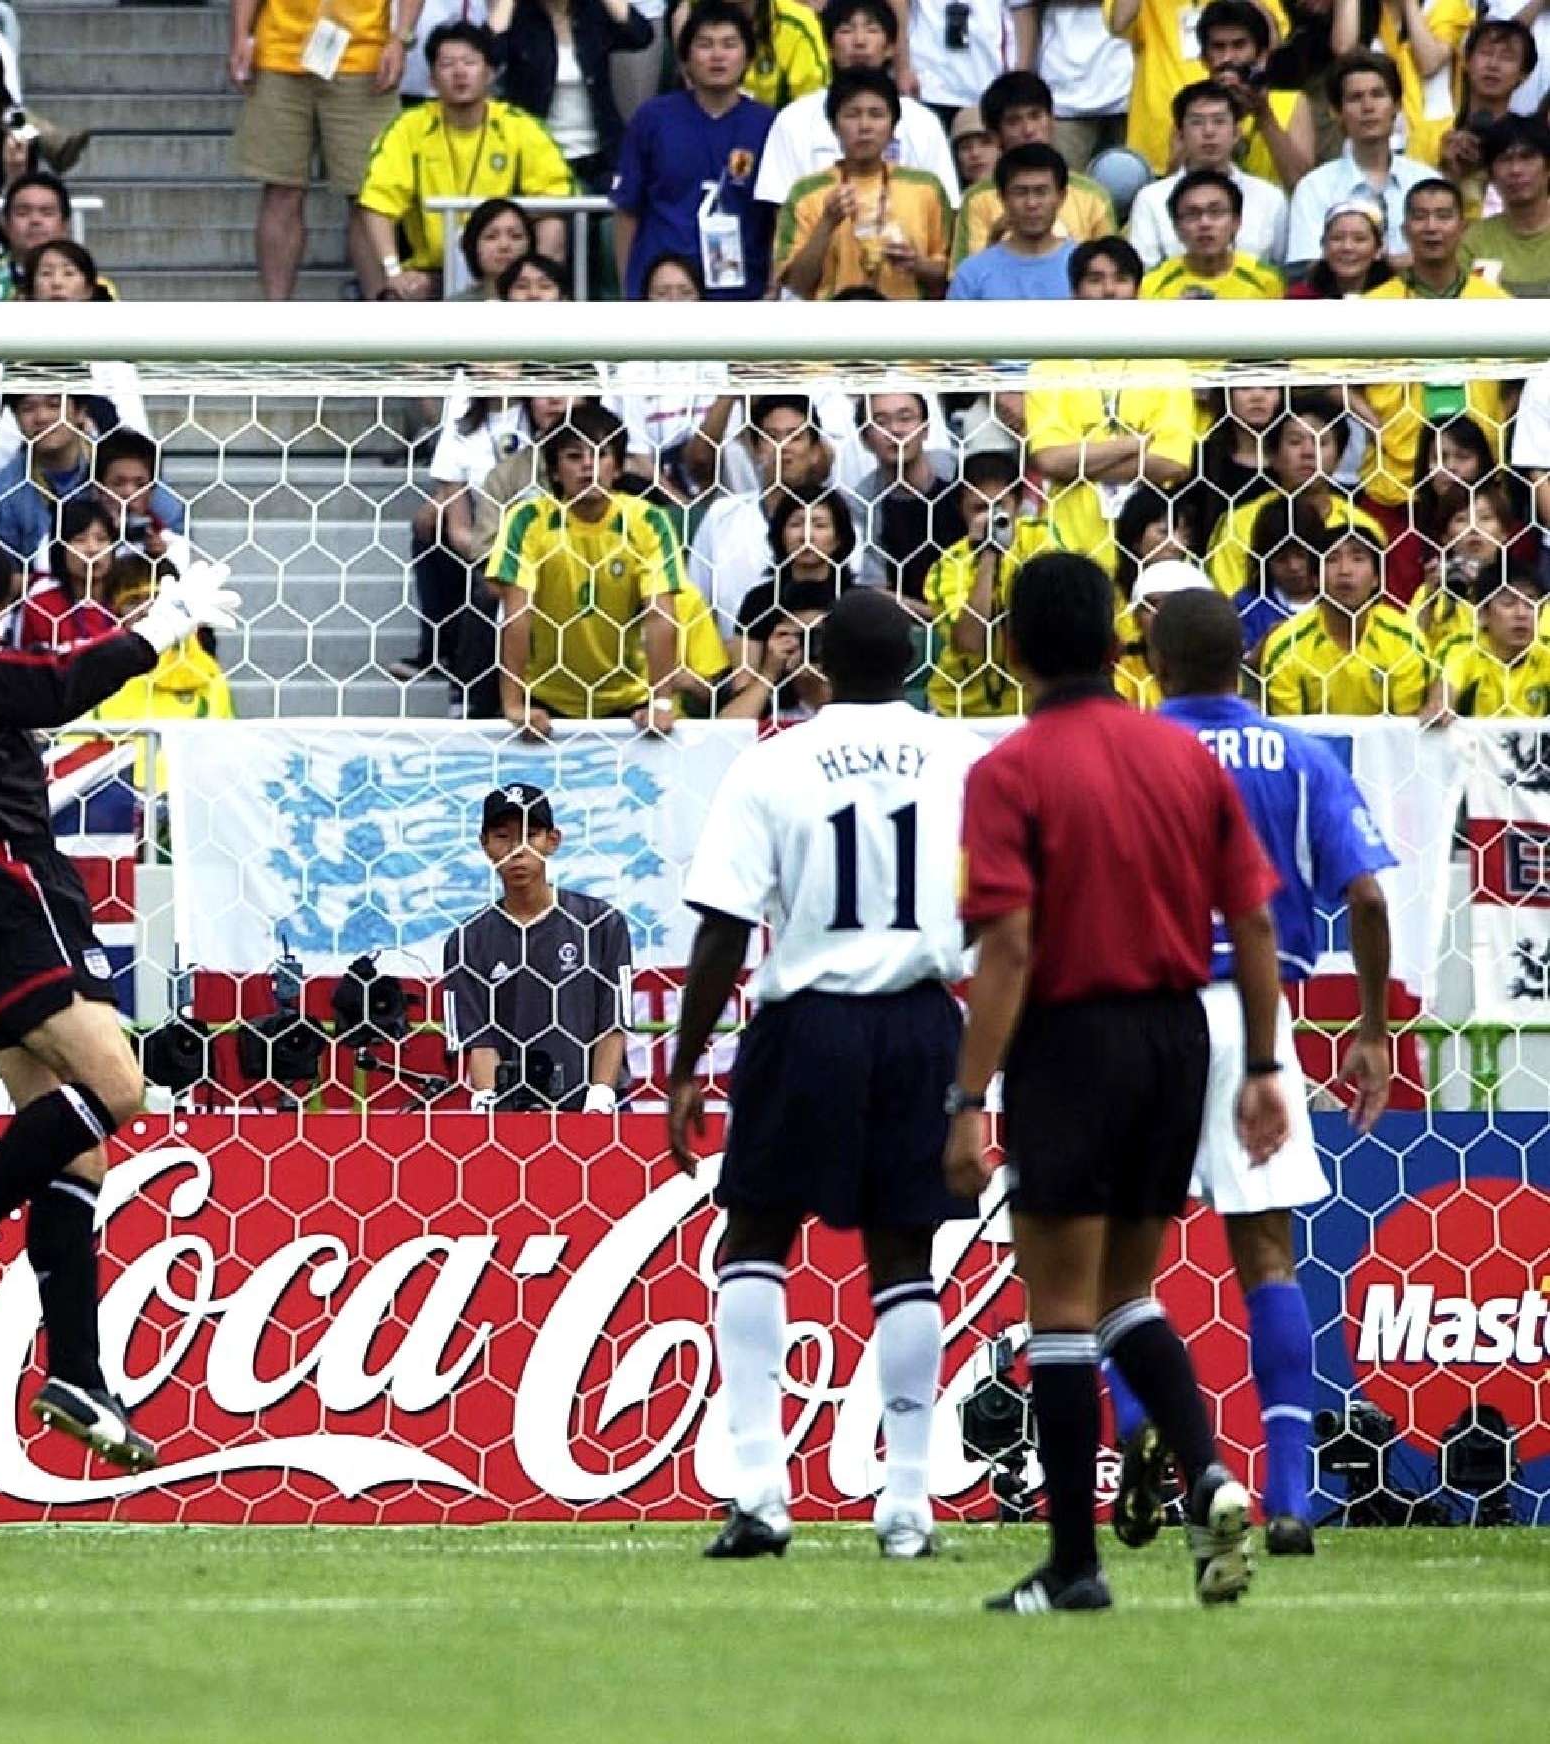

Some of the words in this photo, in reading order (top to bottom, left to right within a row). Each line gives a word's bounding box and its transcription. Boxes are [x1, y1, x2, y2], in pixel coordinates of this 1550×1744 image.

[816, 744, 931, 783] HESKEY
[824, 801, 922, 932] 11
[1356, 1283, 1550, 1364] Mast
